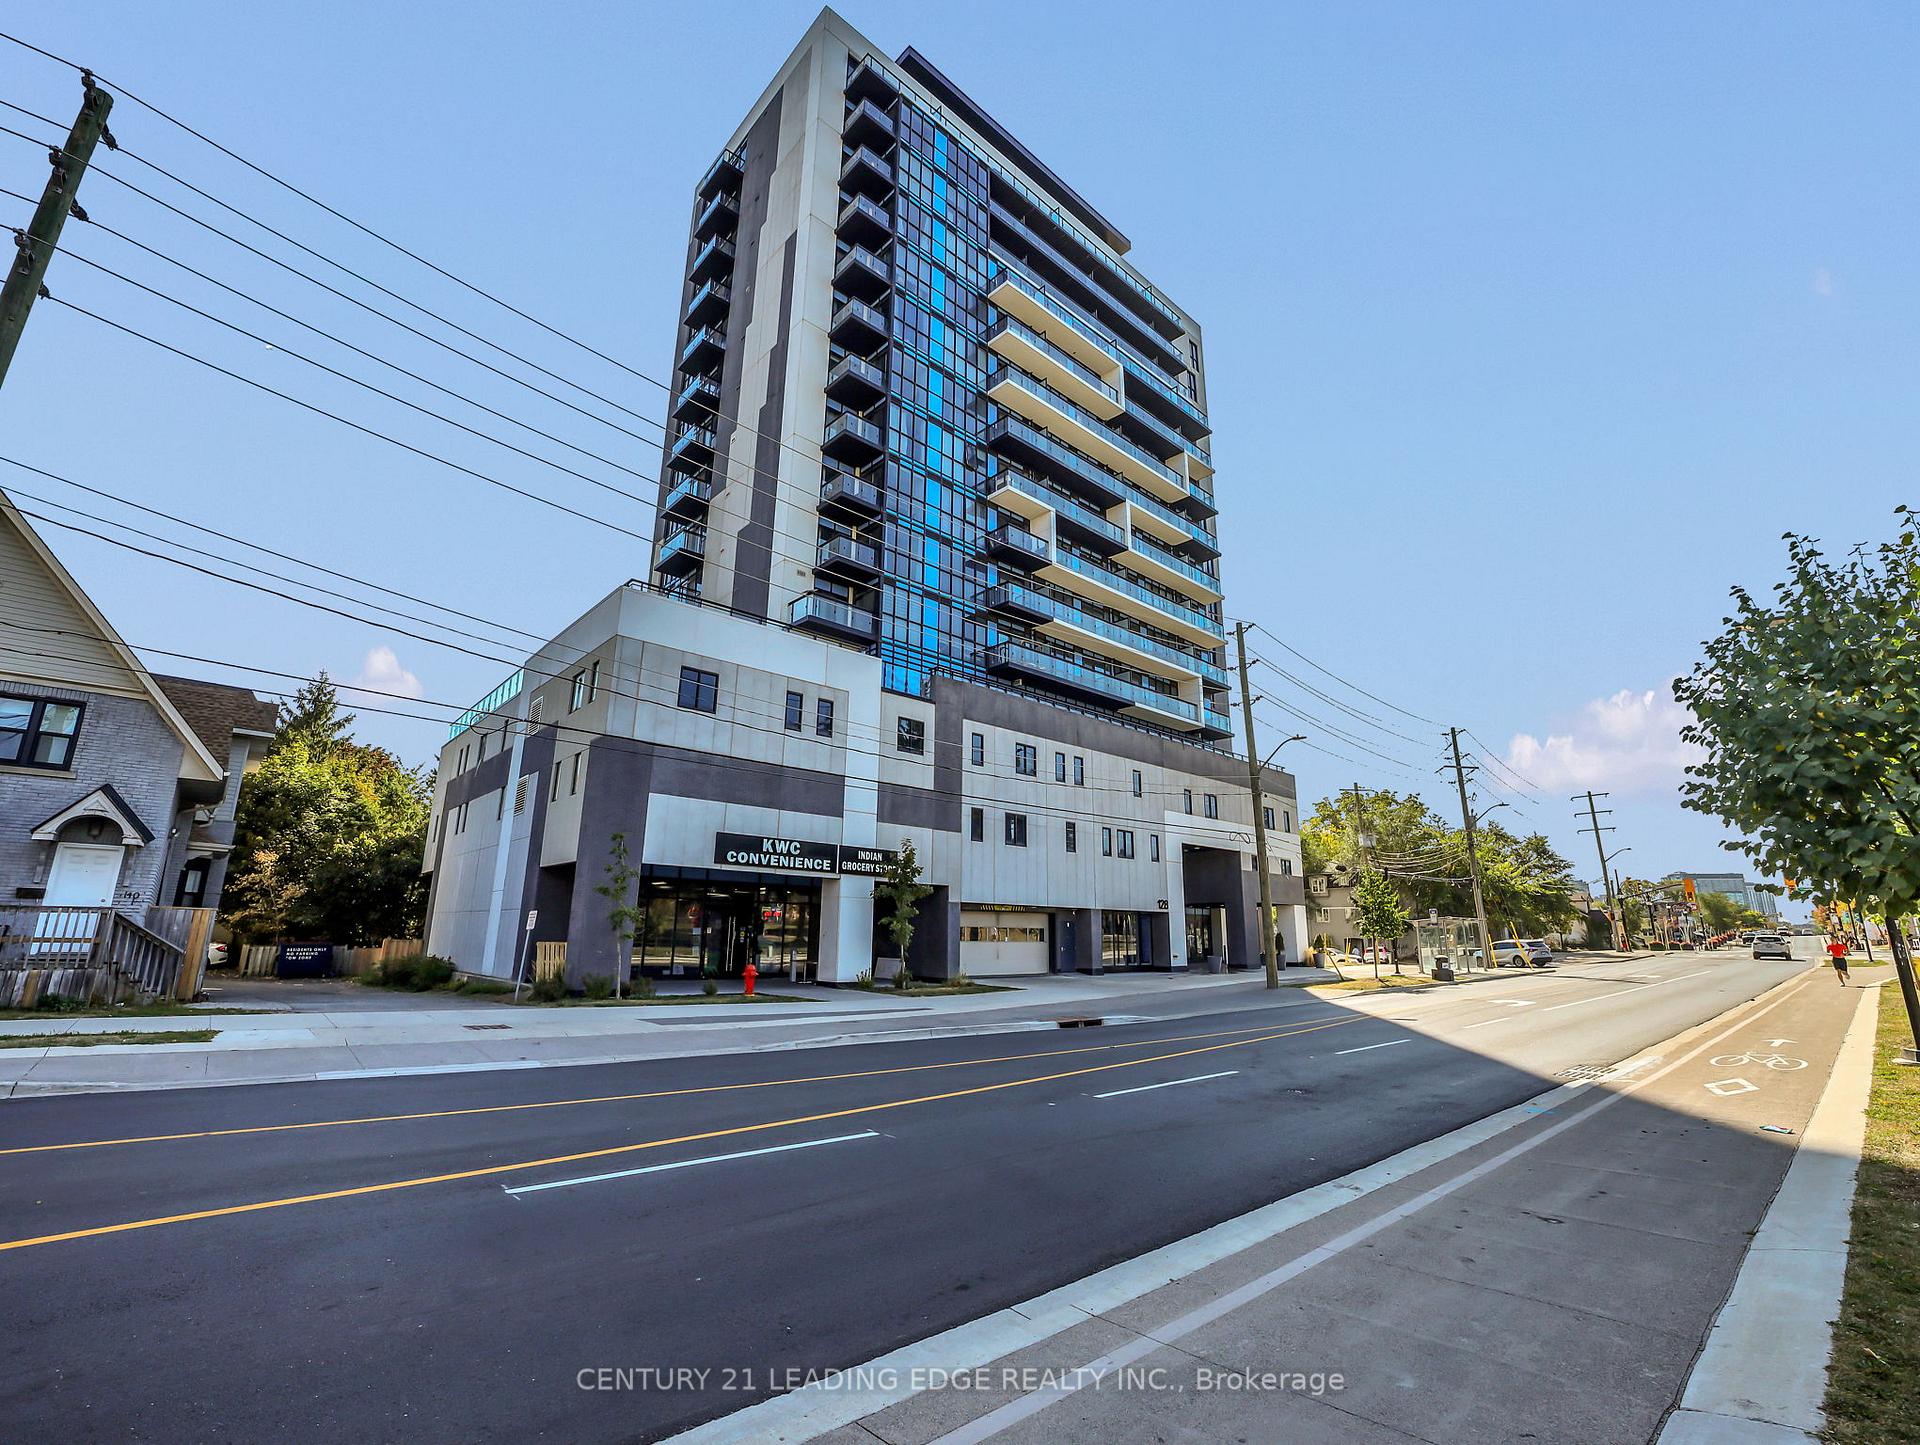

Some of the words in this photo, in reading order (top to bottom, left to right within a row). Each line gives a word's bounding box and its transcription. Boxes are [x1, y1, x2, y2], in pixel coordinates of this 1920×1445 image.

[762, 838, 800, 855] KWC
[726, 850, 831, 871] CONVENIENCE
[858, 850, 883, 862] INDIAN
[841, 860, 875, 873] GROCERY
[1157, 899, 1169, 909] 128
